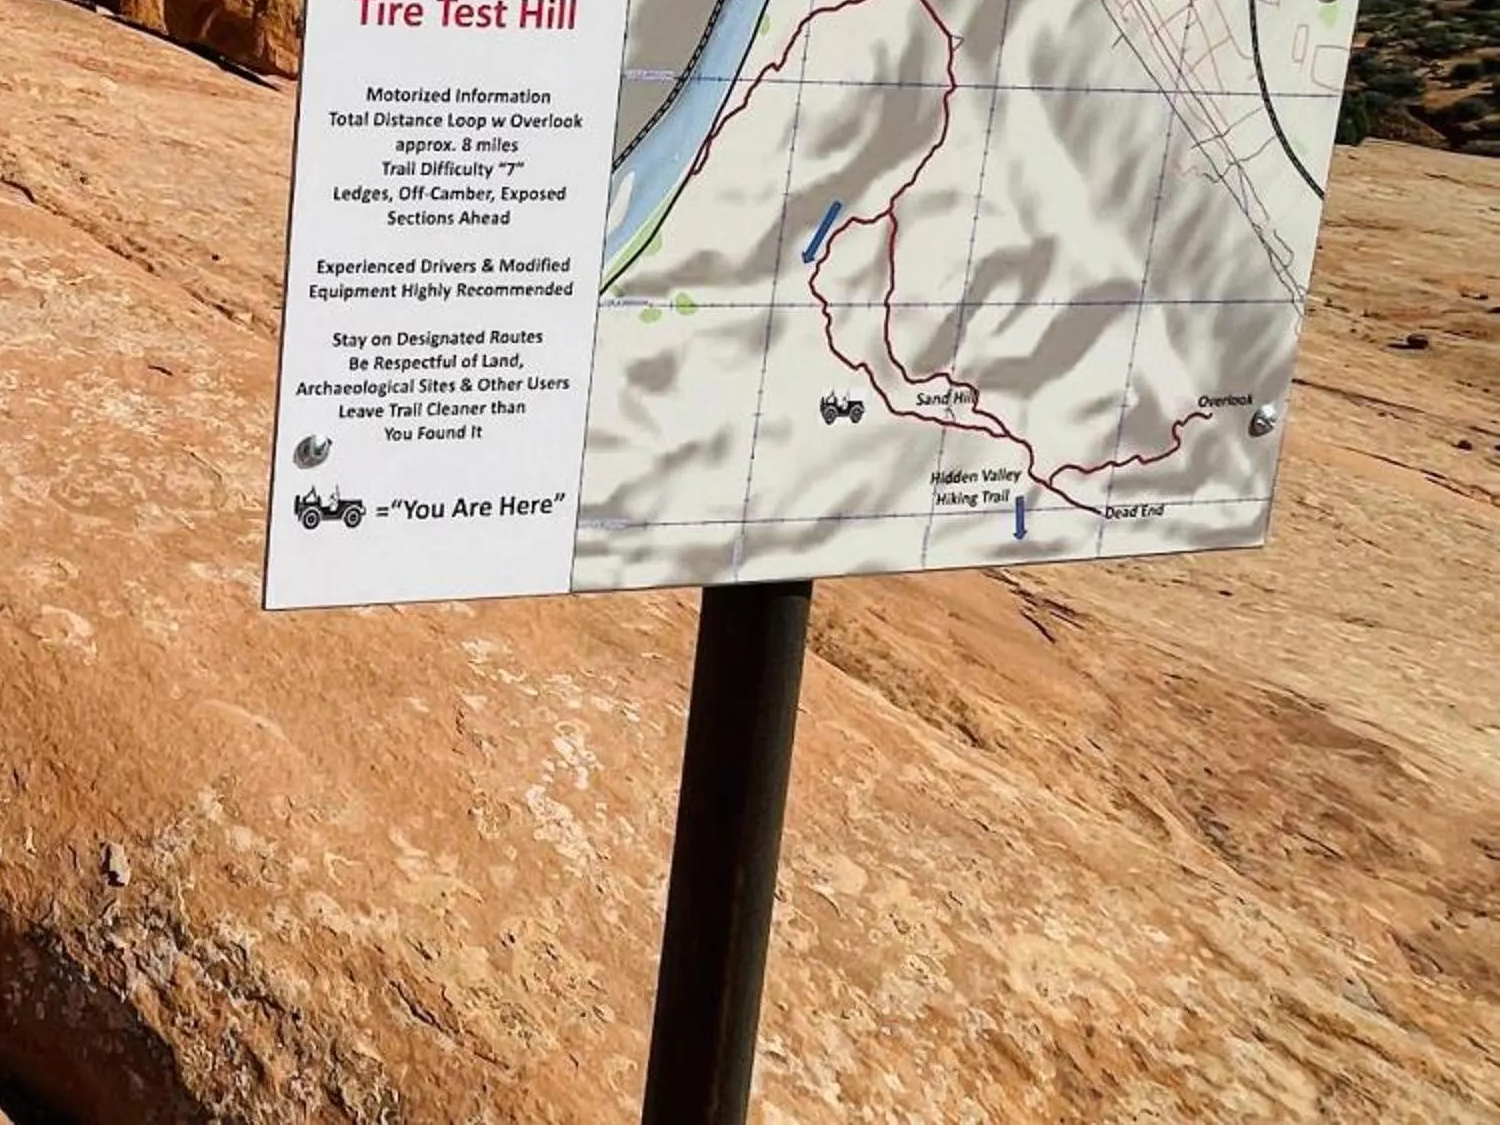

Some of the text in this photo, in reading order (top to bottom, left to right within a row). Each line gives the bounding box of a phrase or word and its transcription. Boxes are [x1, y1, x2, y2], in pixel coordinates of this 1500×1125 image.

[366, 87, 551, 104] Motorized Information
[329, 112, 582, 131] Total Distance Loop w Overlook
[396, 138, 519, 156] approx. 8 miles
[382, 161, 415, 176] Trail
[420, 161, 493, 180] Difficulty
[332, 186, 566, 205] Ledges, Off-Camber, Exposed
[388, 210, 510, 226] Sections Ahead
[317, 257, 570, 277] Experienced Drivers & Modified
[309, 281, 573, 303] Equipment Highly Recommended
[332, 330, 543, 351] Stay on Designated Routes
[349, 353, 524, 374] Be Respectful of Land,
[296, 376, 570, 398] Archaeological Sites & Other Users
[915, 392, 950, 407] Sand
[1198, 394, 1254, 408] Overlook
[339, 401, 526, 419] Leave Trail Cleaner than
[384, 426, 482, 442] You Found It
[931, 469, 1022, 486] Hidden Valley
[452, 496, 492, 518] Are
[499, 493, 566, 516] Here”
[936, 490, 1010, 508] Hiking Trail
[1104, 503, 1165, 519] Dead End
